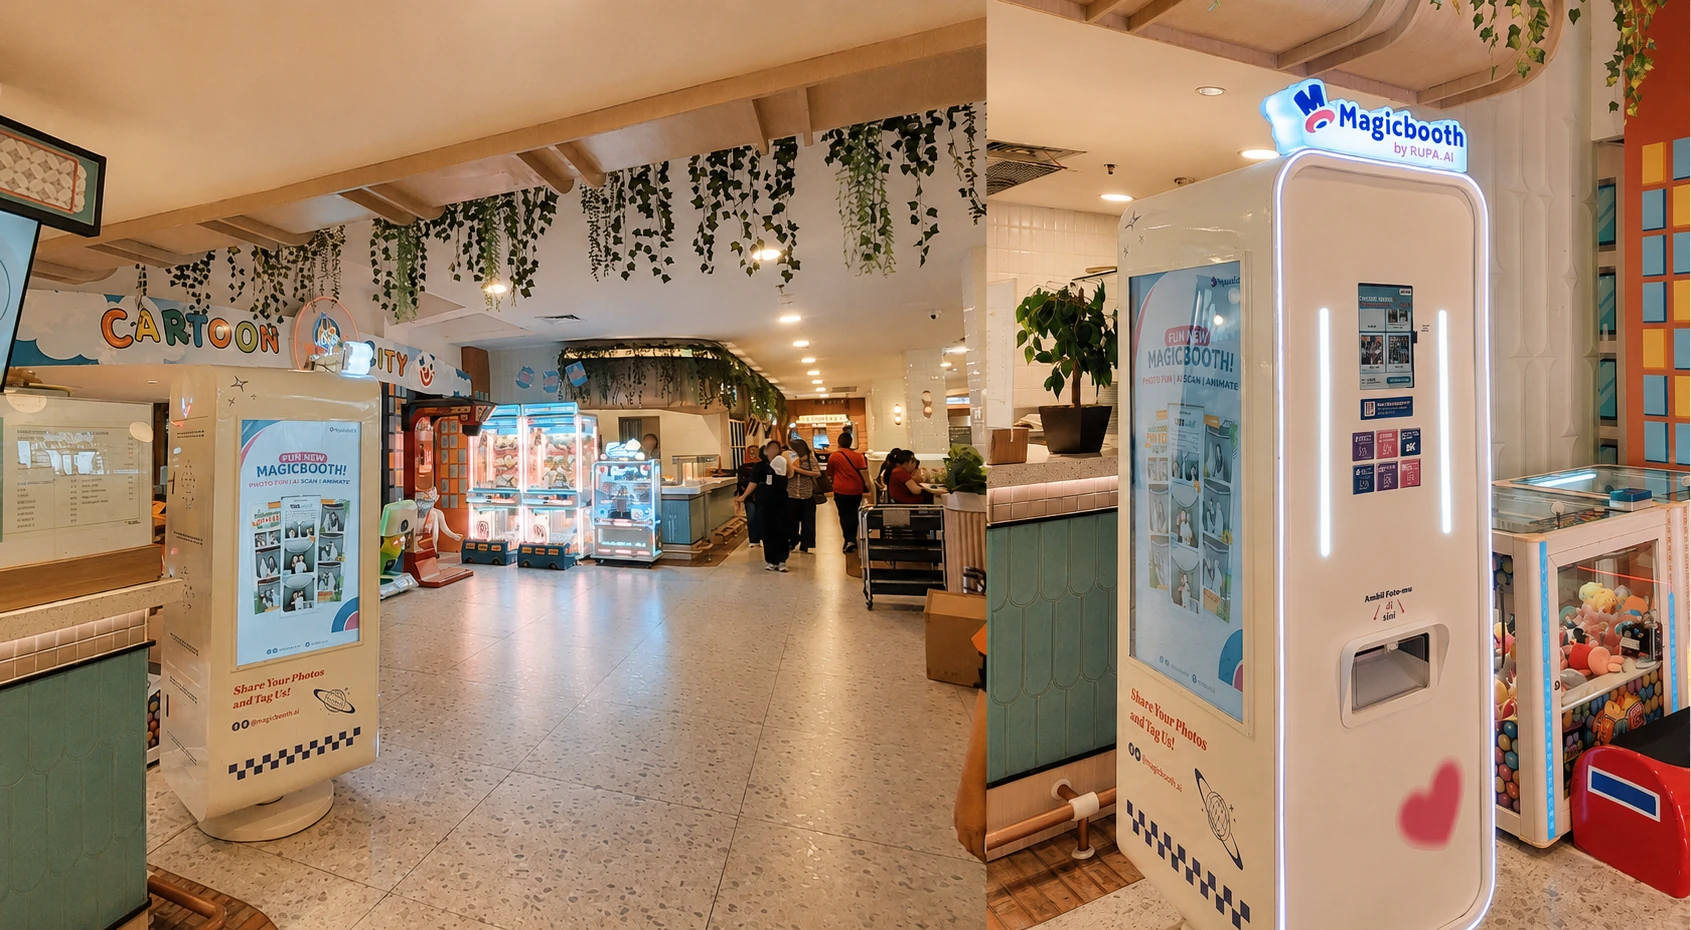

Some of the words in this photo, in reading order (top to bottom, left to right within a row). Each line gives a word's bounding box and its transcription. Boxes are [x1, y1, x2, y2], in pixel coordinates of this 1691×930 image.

[1340, 103, 1464, 147] Magicbooth
[1394, 142, 1407, 157] by
[1411, 145, 1454, 162] RUPA.AI
[100, 308, 280, 354] CARTOON
[364, 340, 408, 377] ITY
[1168, 330, 1185, 343] FUN
[1186, 328, 1209, 344] NEW
[1148, 346, 1234, 372] MAGICBOOTH!
[1183, 374, 1201, 384] SCAN
[1206, 378, 1239, 390] ANIMATE
[304, 453, 325, 462] NEW
[256, 463, 347, 477] MAGICBOOTH!
[1364, 591, 1385, 603] Ambil
[1385, 586, 1412, 598] Foto-mu
[1386, 600, 1393, 610] di
[1383, 611, 1396, 621] sini
[232, 682, 265, 696] Share
[267, 676, 290, 688] Your
[291, 669, 325, 683] Photos
[232, 696, 253, 709] and
[254, 692, 272, 704] Tag
[275, 687, 291, 700] Us!
[1130, 688, 1154, 713] Share
[1154, 702, 1175, 727] Your
[1176, 718, 1208, 751] Photos
[1130, 712, 1144, 729] and
[1145, 719, 1160, 744] Tag
[1162, 731, 1175, 751] Us!
